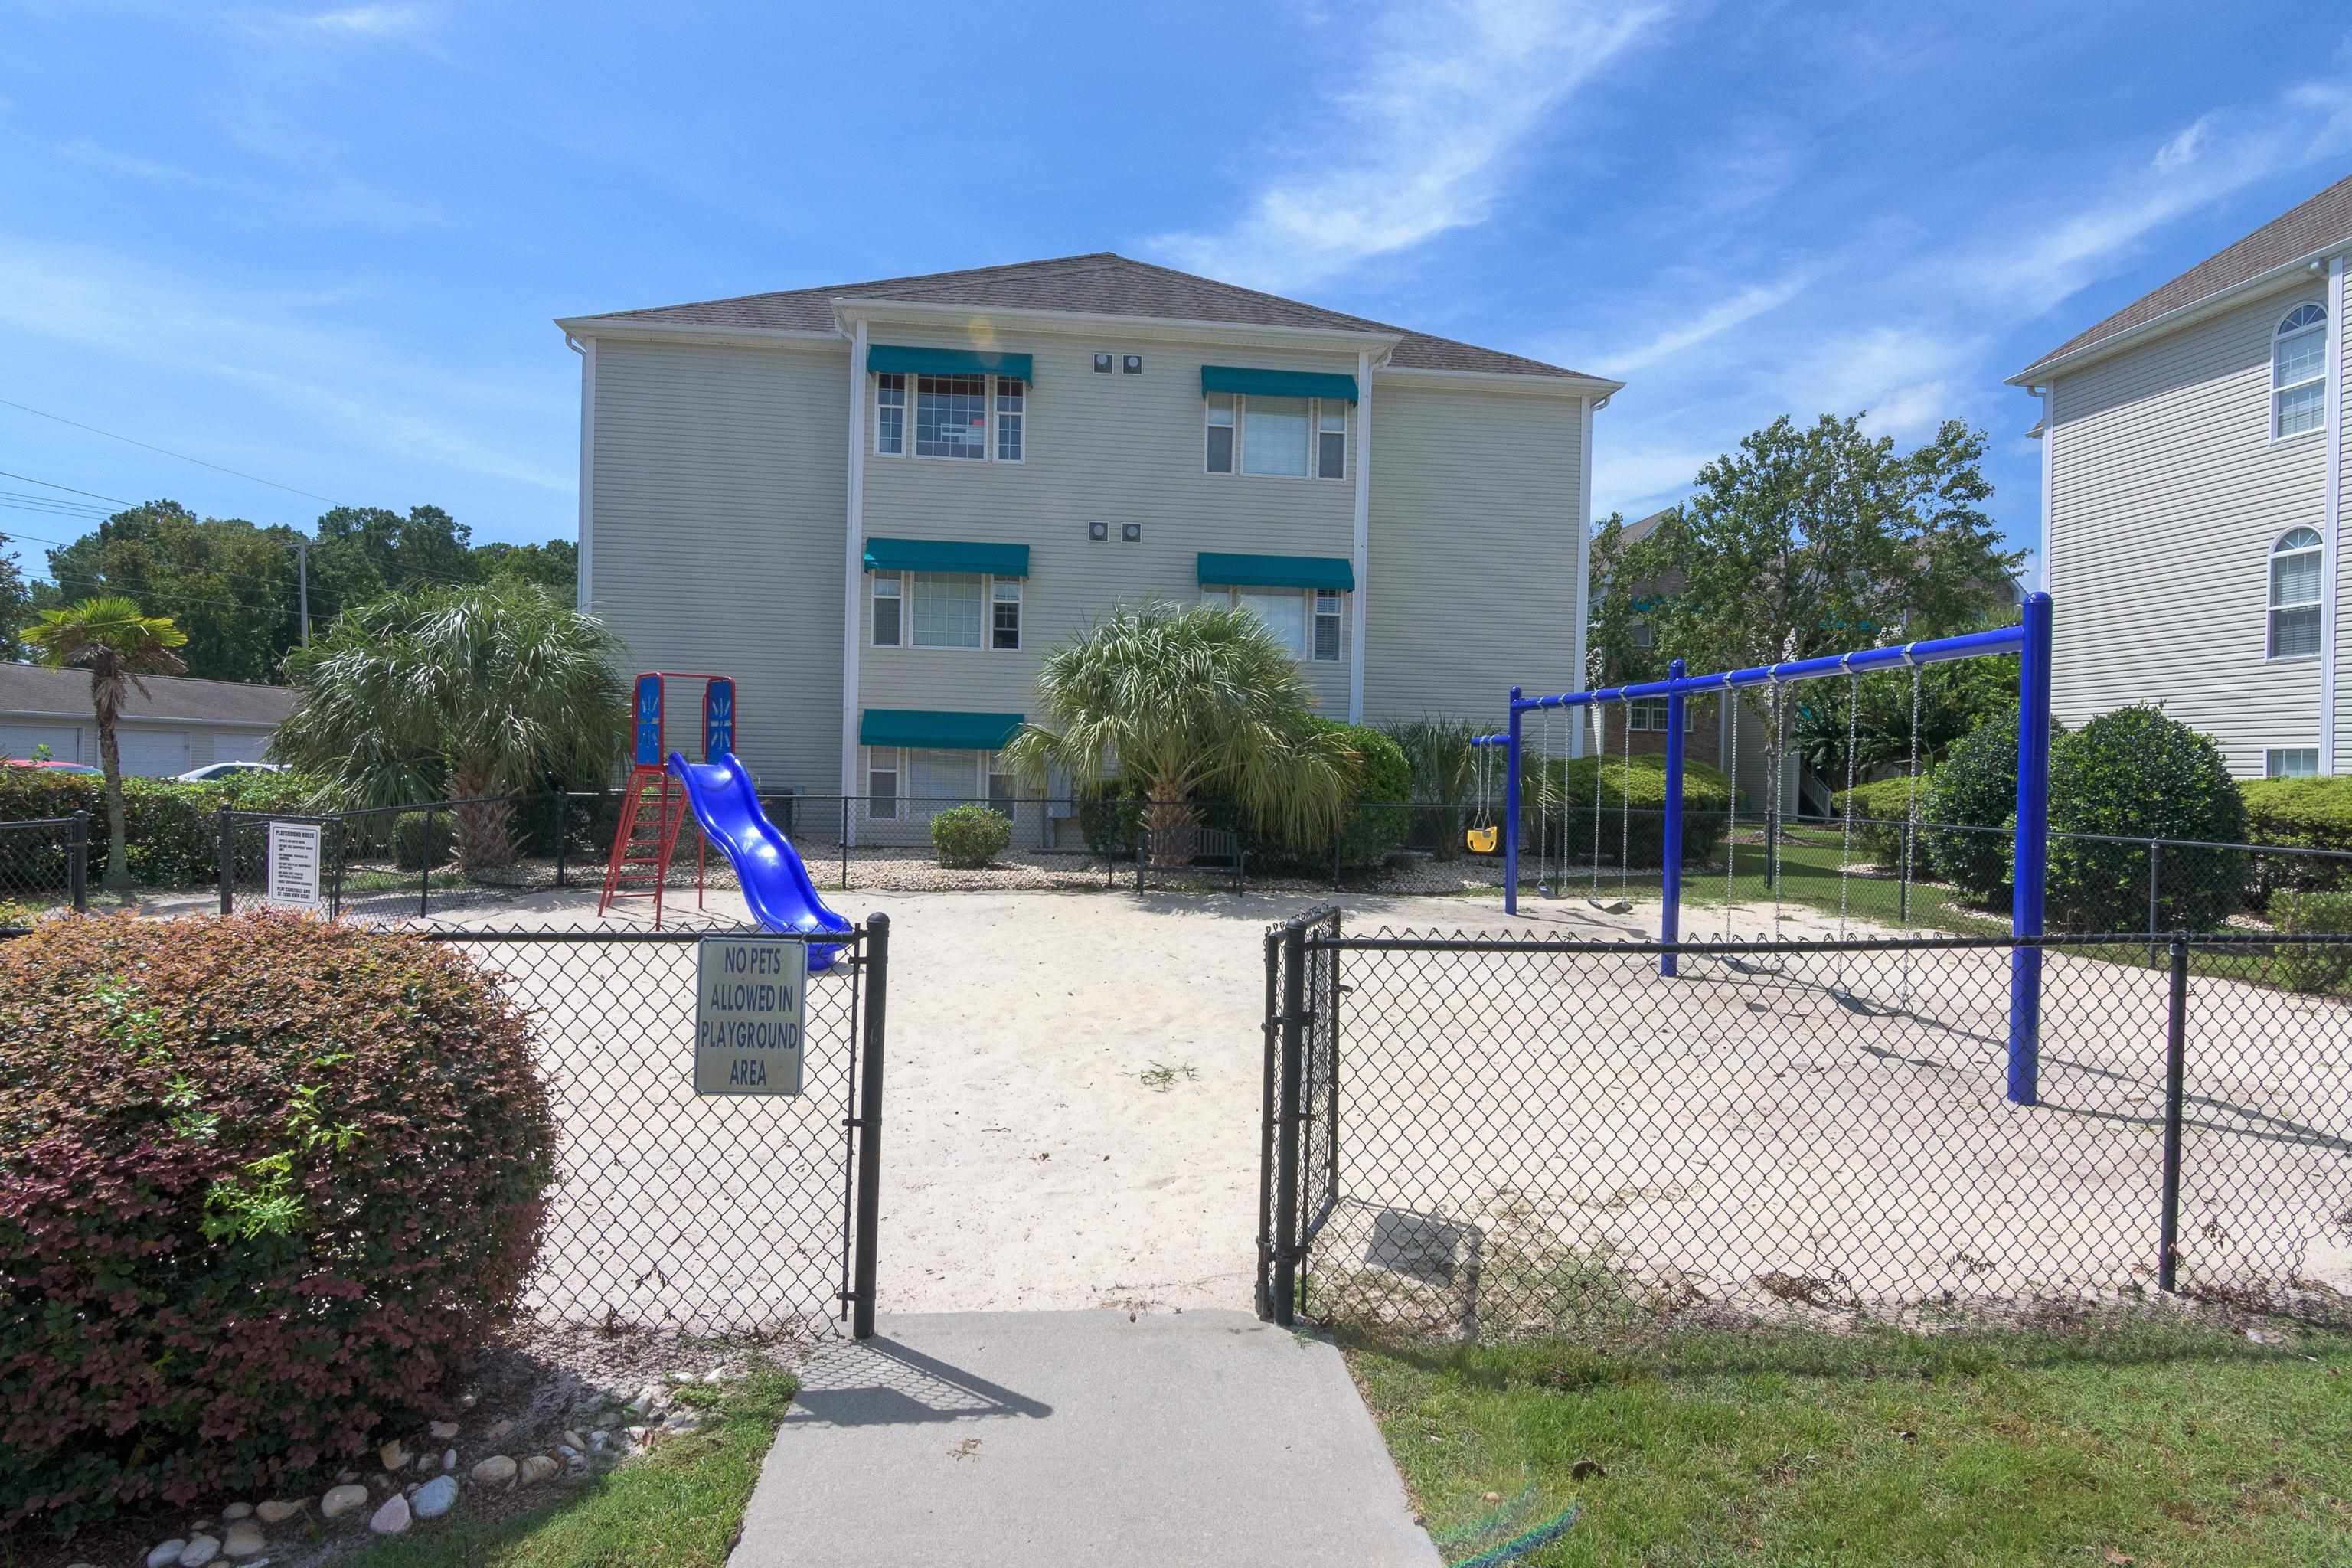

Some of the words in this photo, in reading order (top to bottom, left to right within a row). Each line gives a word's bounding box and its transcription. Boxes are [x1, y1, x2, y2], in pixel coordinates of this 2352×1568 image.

[724, 947, 747, 973] NO
[750, 947, 781, 975] PETS
[710, 984, 775, 1011] ALLOWED
[778, 985, 793, 1012] IN
[701, 1021, 798, 1049] PLAYGROUND
[729, 1059, 766, 1086] AREA
